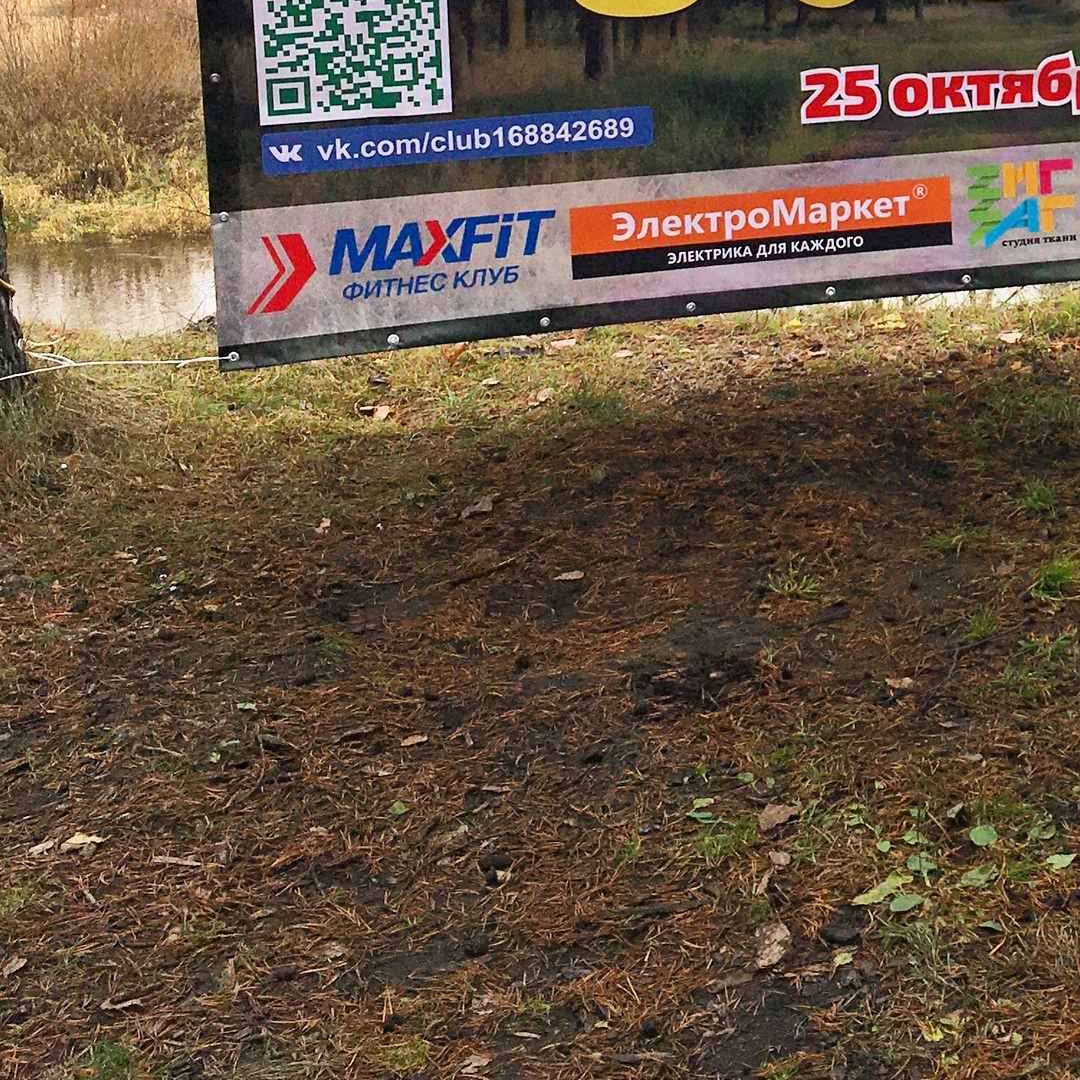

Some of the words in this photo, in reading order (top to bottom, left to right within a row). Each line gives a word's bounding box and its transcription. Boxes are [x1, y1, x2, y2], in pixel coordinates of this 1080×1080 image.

[801, 64, 880, 122] 25
[317, 116, 634, 161] vk.com/club168842689
[667, 245, 752, 264] ЭЛЕКТРИКА
[756, 241, 787, 258] ДЛЯ
[790, 234, 864, 255] КАЖДОГО
[1001, 235, 1041, 248] студия
[1042, 232, 1077, 244] ткани
[342, 270, 446, 301] ФИТНЕС
[452, 265, 520, 289] КЛУБ
